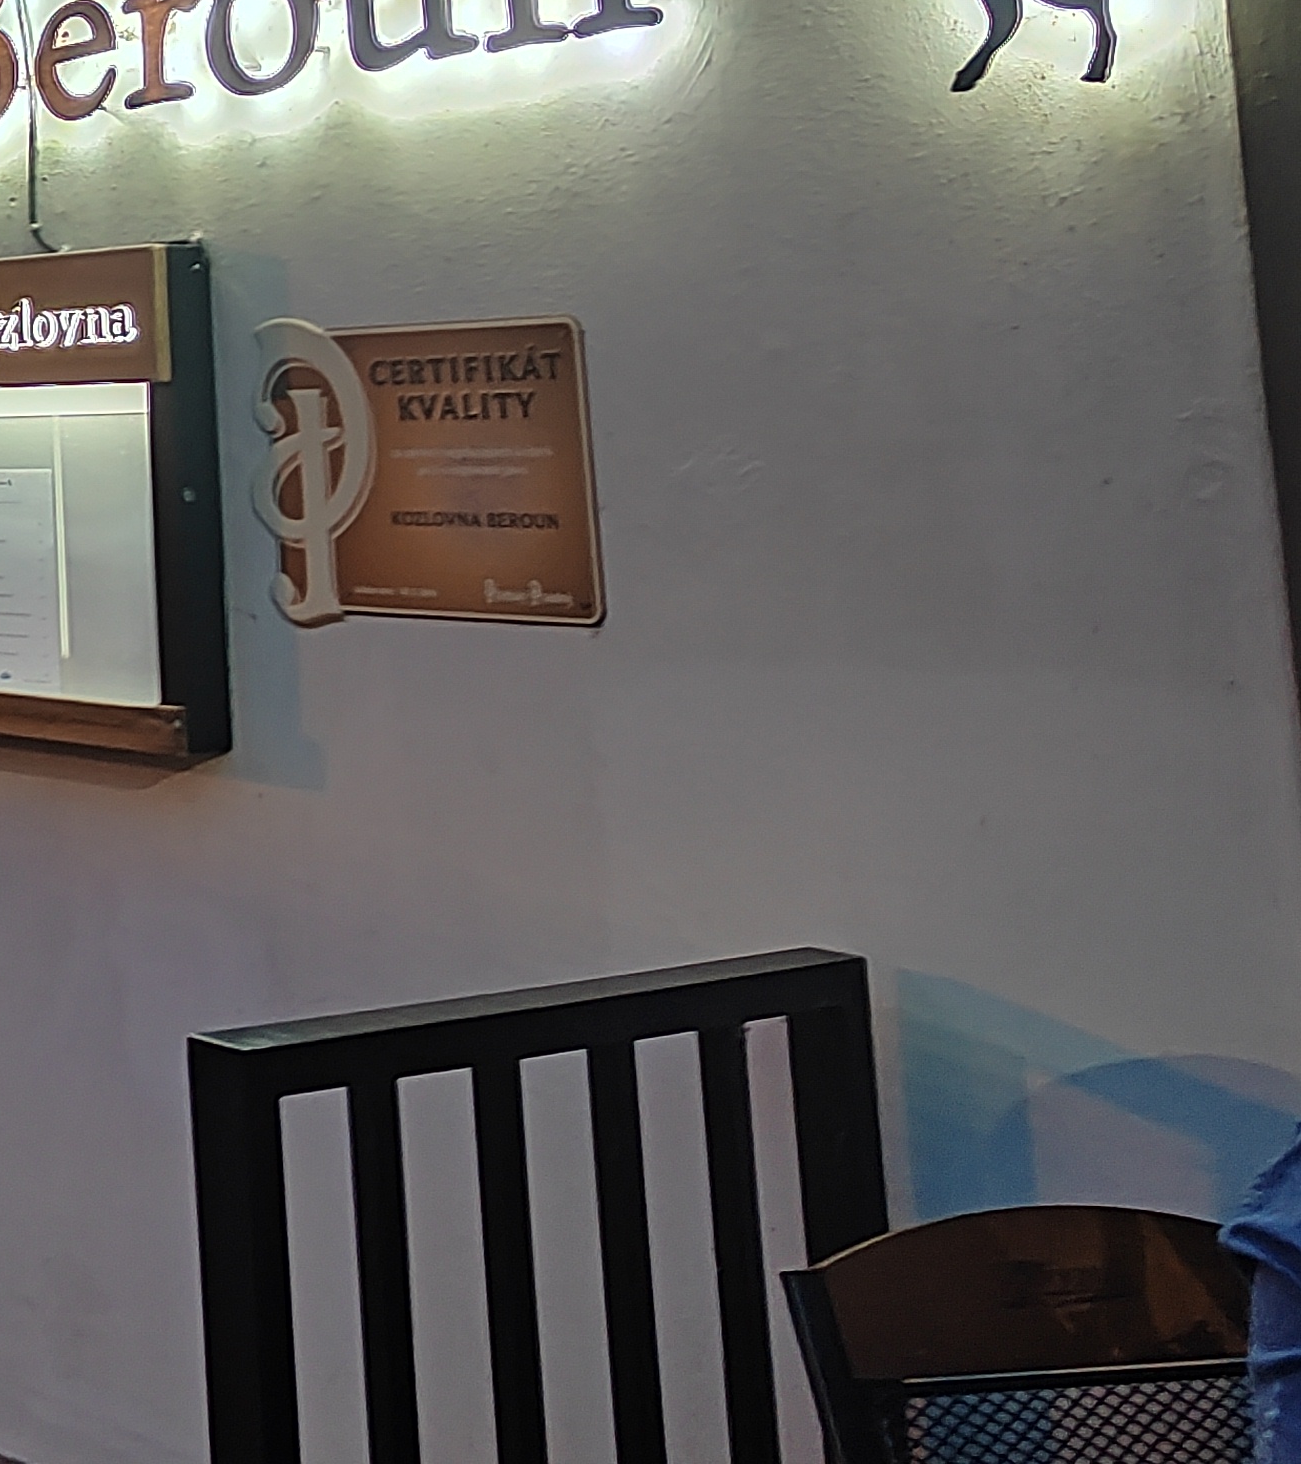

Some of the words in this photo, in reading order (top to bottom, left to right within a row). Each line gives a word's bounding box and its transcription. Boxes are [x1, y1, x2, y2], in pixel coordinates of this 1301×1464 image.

[367, 343, 561, 386] CERTIFIKÁT
[398, 390, 537, 422] KVALITY
[391, 510, 481, 529] KOZLOVNA
[486, 512, 560, 530] BEROUN
